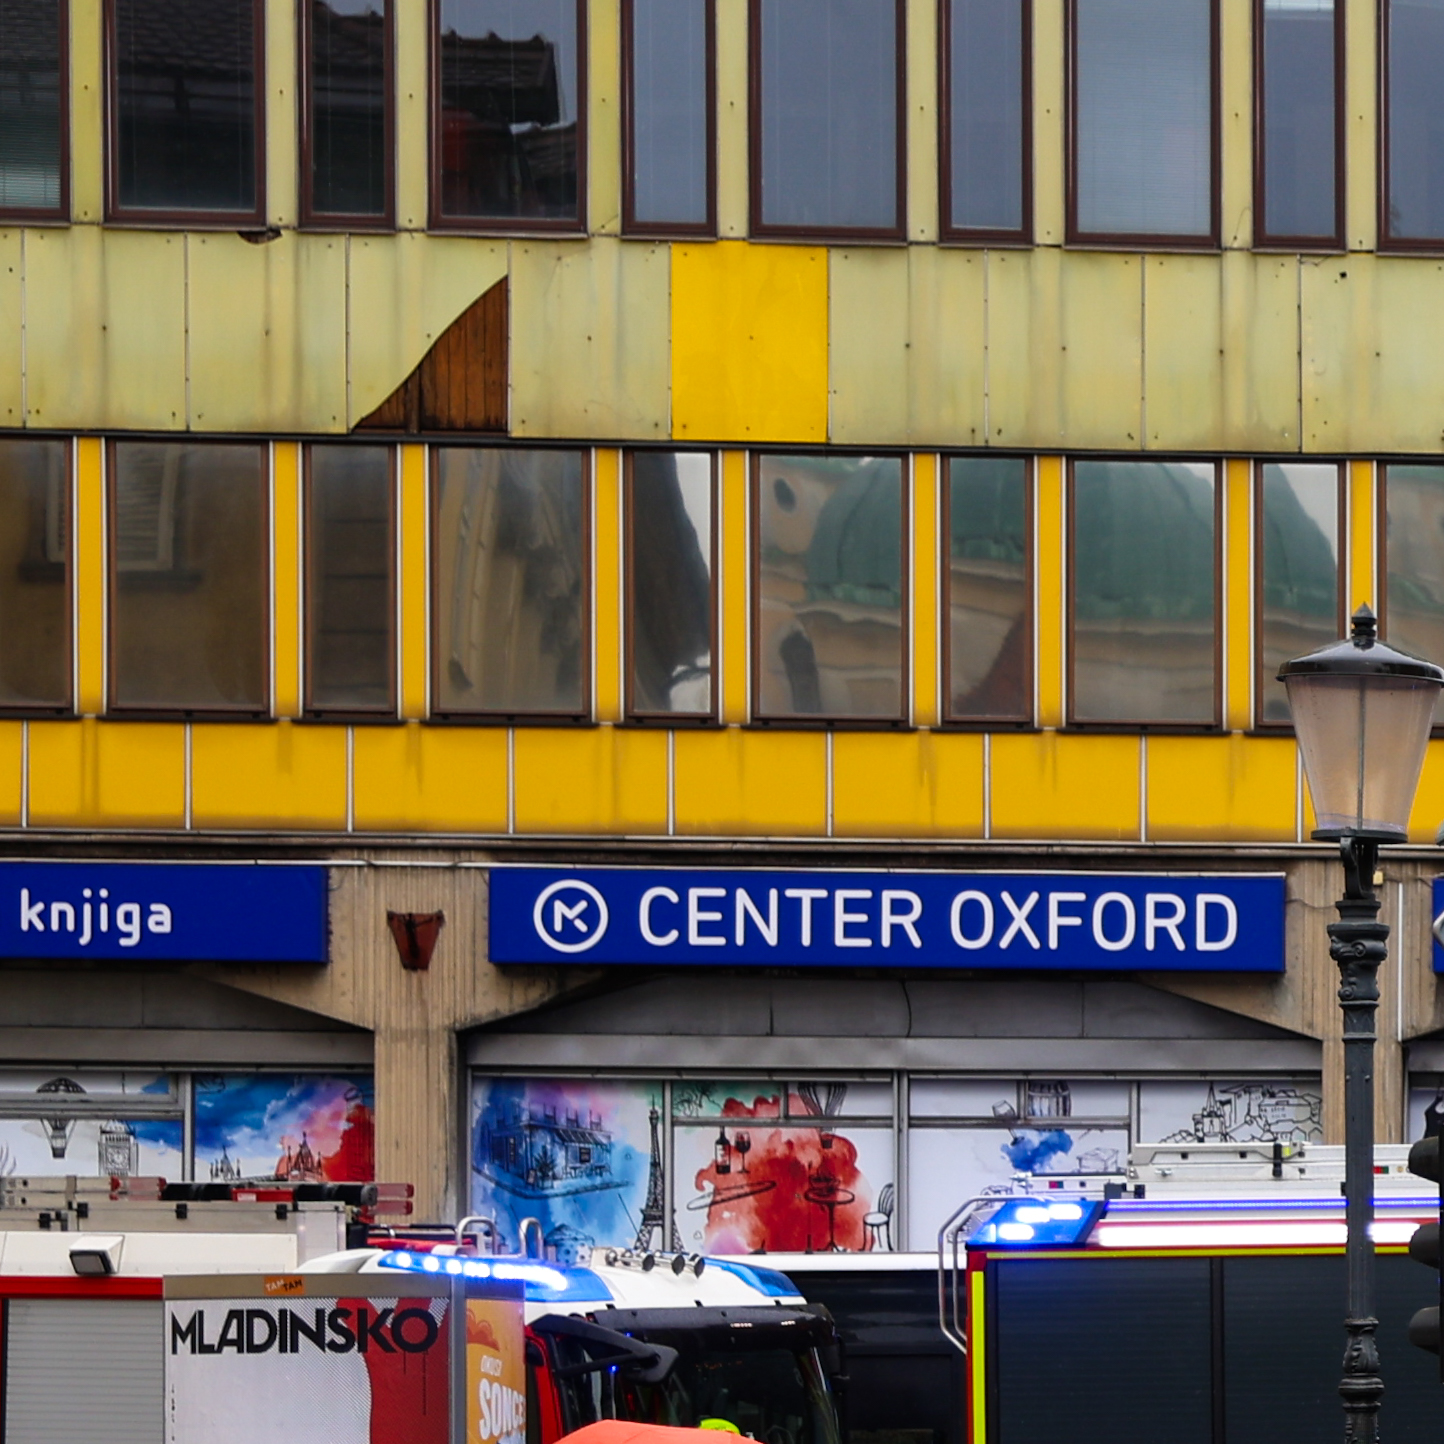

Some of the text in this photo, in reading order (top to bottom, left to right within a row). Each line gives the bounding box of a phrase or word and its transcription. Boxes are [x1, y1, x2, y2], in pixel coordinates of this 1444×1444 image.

[20, 888, 173, 947] knjiga
[639, 886, 923, 949] CENTER
[950, 889, 1239, 952] OXFORD
[265, 1278, 303, 1292] TAM TAM
[170, 1307, 439, 1355] MLADINSKO
